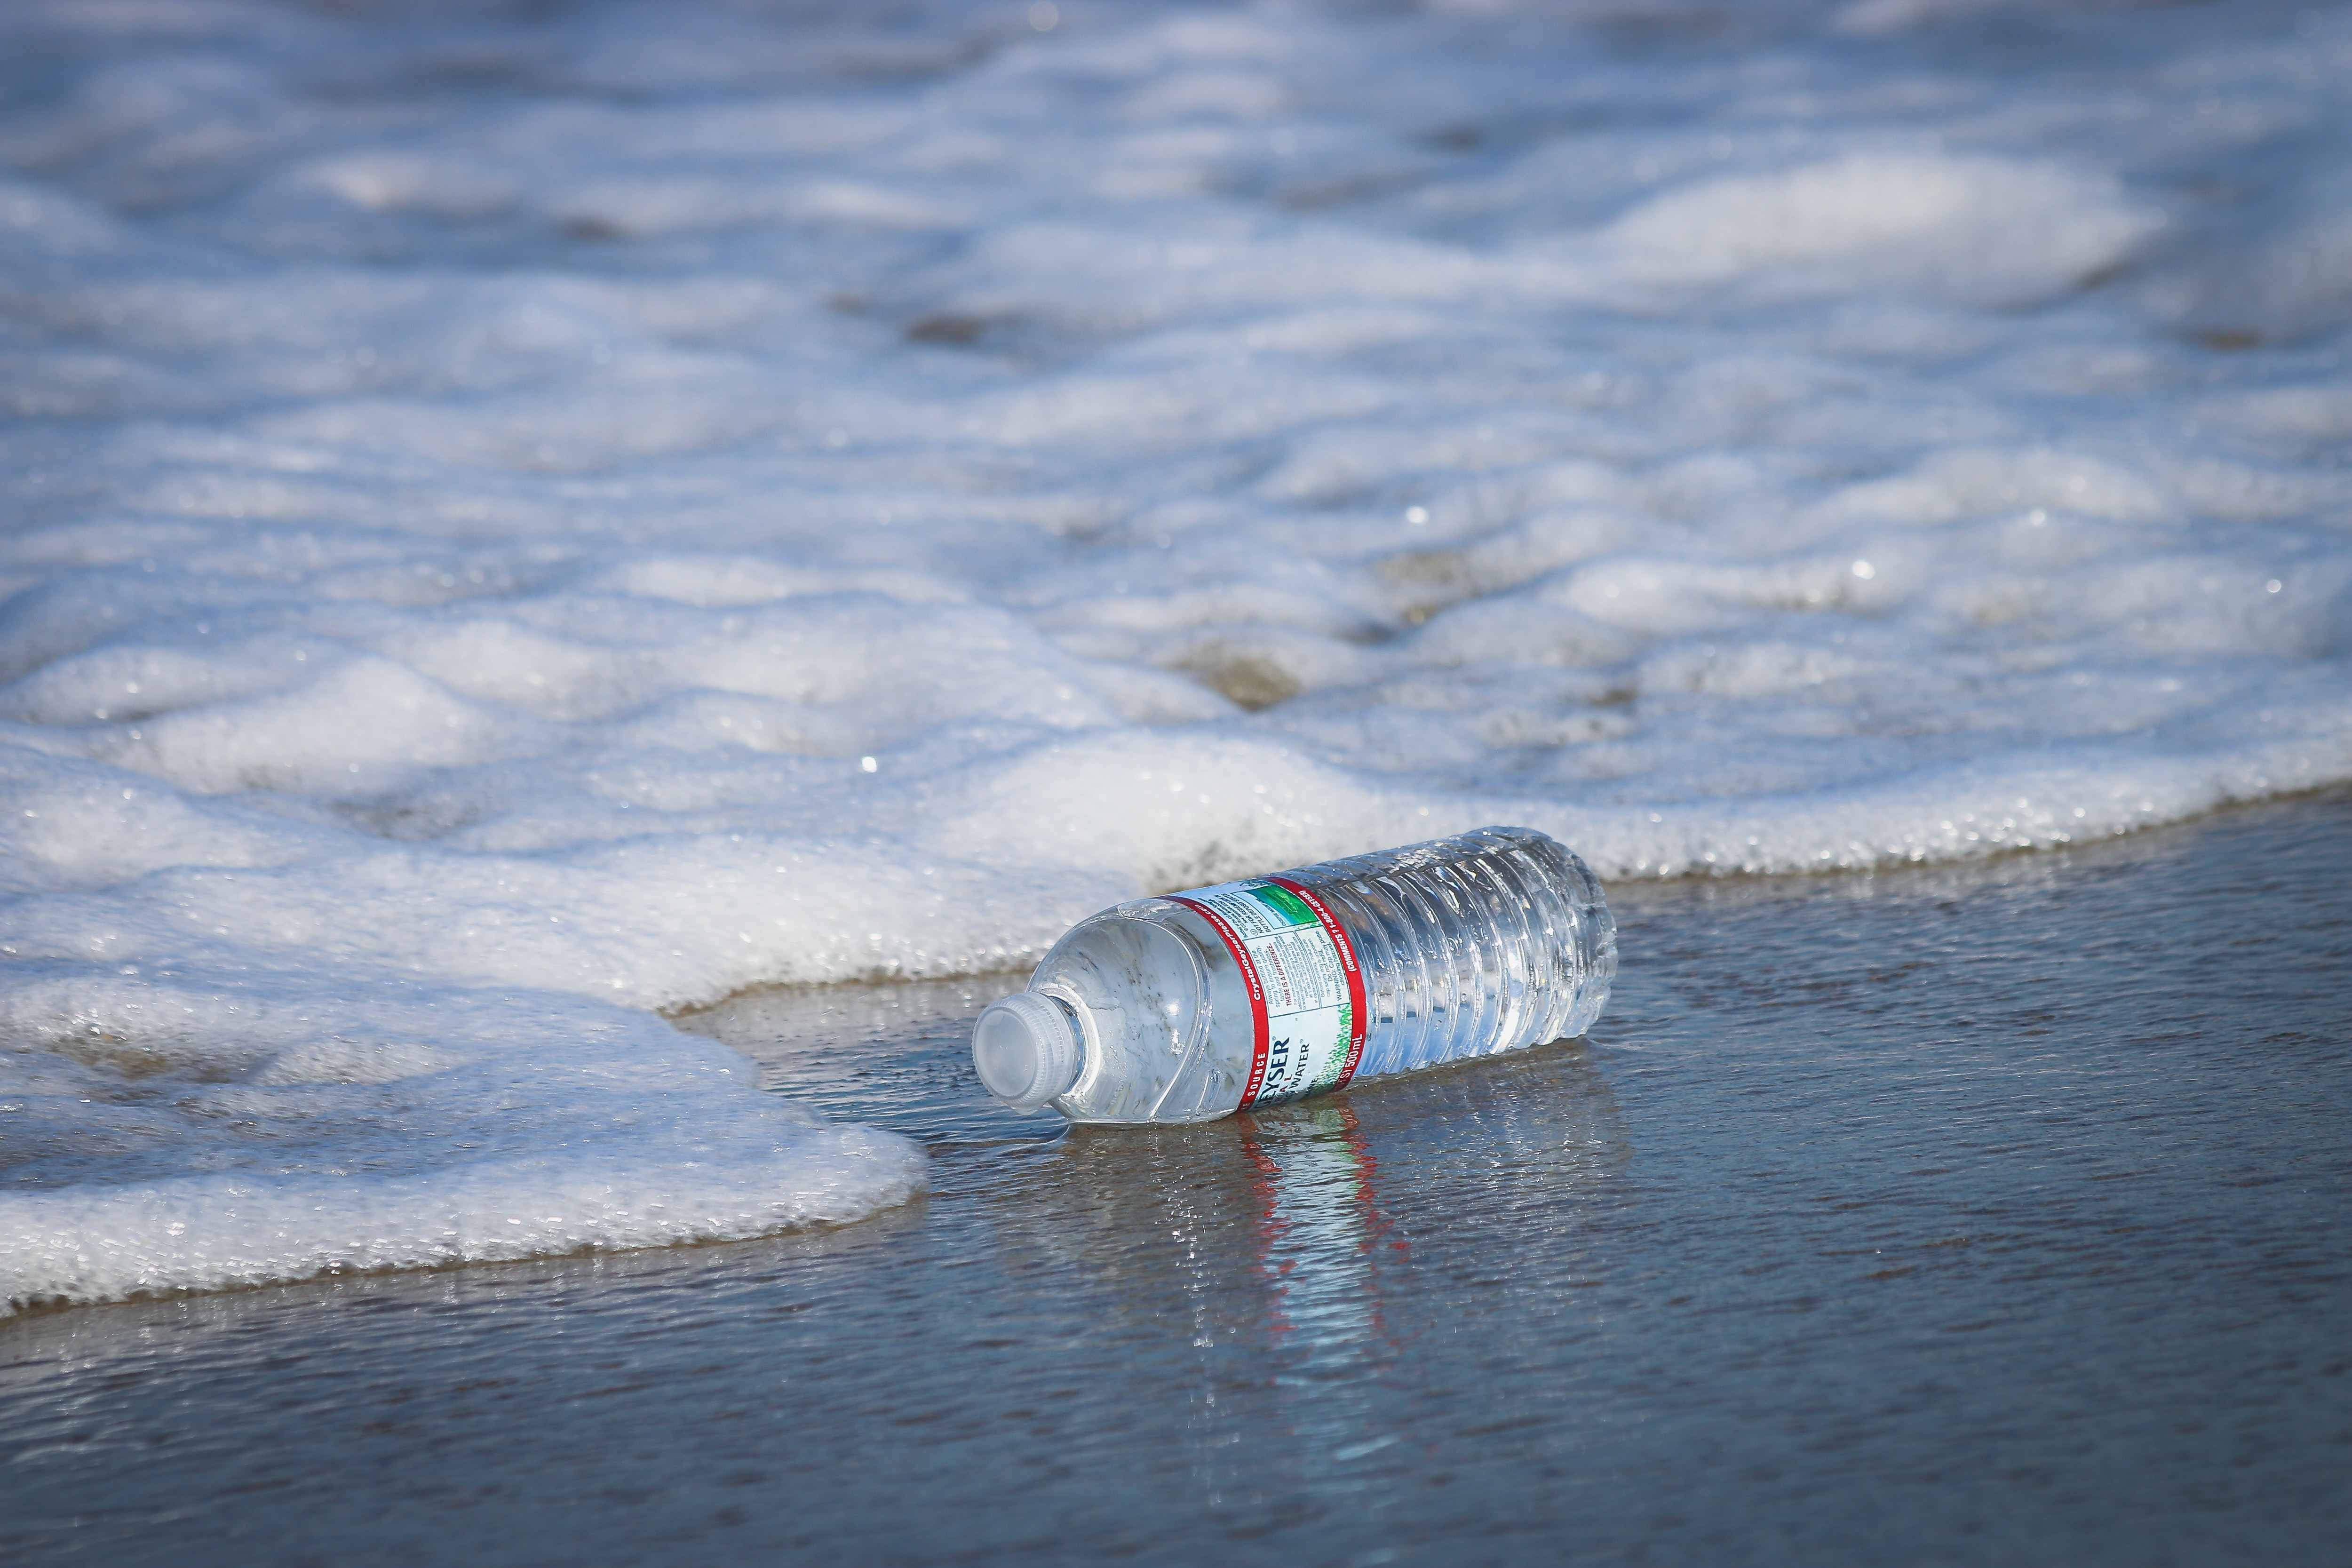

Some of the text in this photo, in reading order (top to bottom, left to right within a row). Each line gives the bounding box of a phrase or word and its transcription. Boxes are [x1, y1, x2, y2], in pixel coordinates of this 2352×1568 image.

[1218, 897, 1248, 915] REDEMPTION
[1221, 893, 1239, 902] STATES
[1236, 901, 1256, 915] DEPOSIT
[1298, 890, 1336, 928] 1-800-4-GEYSER)
[1245, 915, 1256, 923] FOR
[1254, 915, 1271, 932] BOTTLE
[1253, 924, 1264, 933] NOT
[1315, 931, 1326, 943] pose
[1195, 904, 1260, 1000] CrystalGeyserPlease.com
[1255, 945, 1267, 963] quality,
[1283, 944, 1291, 957] bottled
[1308, 938, 1319, 958] unbroken.
[1318, 948, 1326, 962] refill.
[1335, 933, 1357, 971] (COMMENTS
[1264, 949, 1277, 975] freshness.
[1266, 943, 1284, 975] DIFFERENCE.
[1281, 949, 1292, 970] information
[1326, 942, 1344, 985] choking hazard.
[1257, 965, 1268, 984] bottled
[1264, 964, 1274, 982] ensure
[1284, 965, 1293, 987] information
[1299, 961, 1311, 993] 1-800-4-GEYSER
[1327, 973, 1333, 982] Do
[1331, 969, 1342, 1001] WARNING:
[1283, 988, 1292, 1006] THERE
[1247, 1053, 1265, 1096] SOURCE
